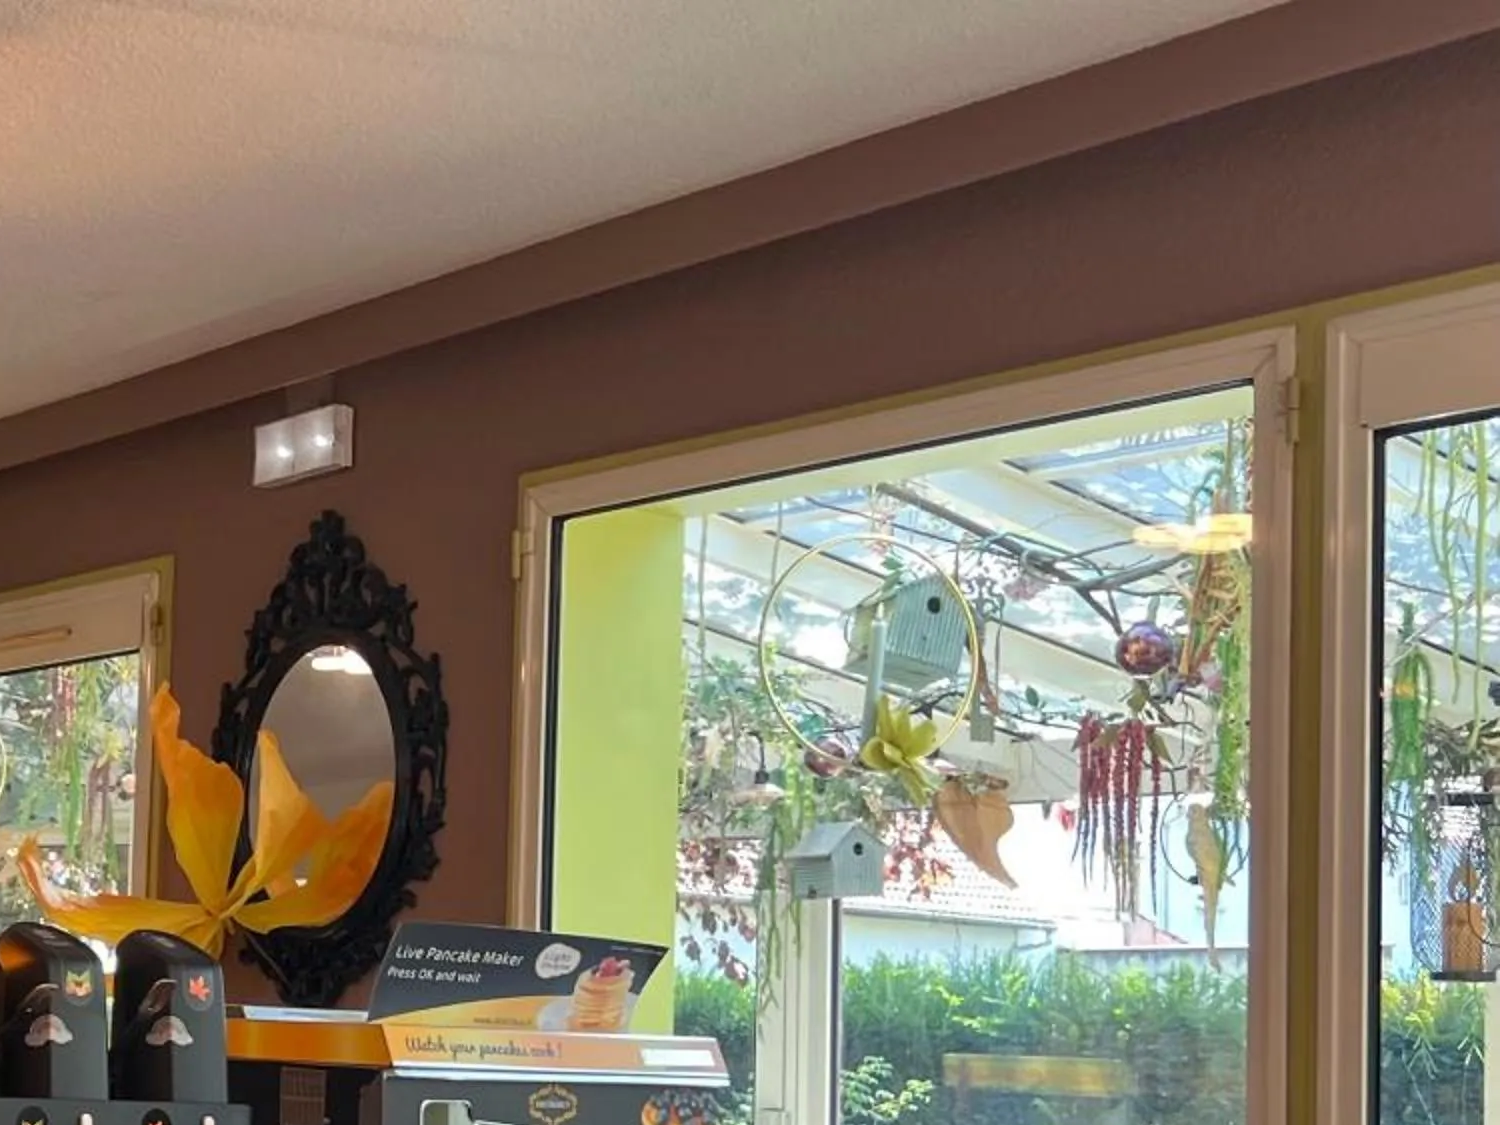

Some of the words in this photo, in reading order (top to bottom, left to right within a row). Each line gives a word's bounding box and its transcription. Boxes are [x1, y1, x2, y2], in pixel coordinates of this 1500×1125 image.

[396, 944, 424, 960] Live
[426, 946, 481, 963] Pancake
[483, 950, 524, 967] Maker
[387, 965, 417, 979] Press
[418, 967, 435, 979] OK
[435, 969, 457, 981] and
[457, 970, 481, 983] wait
[405, 1033, 447, 1053] Watch
[449, 1042, 476, 1061] your
